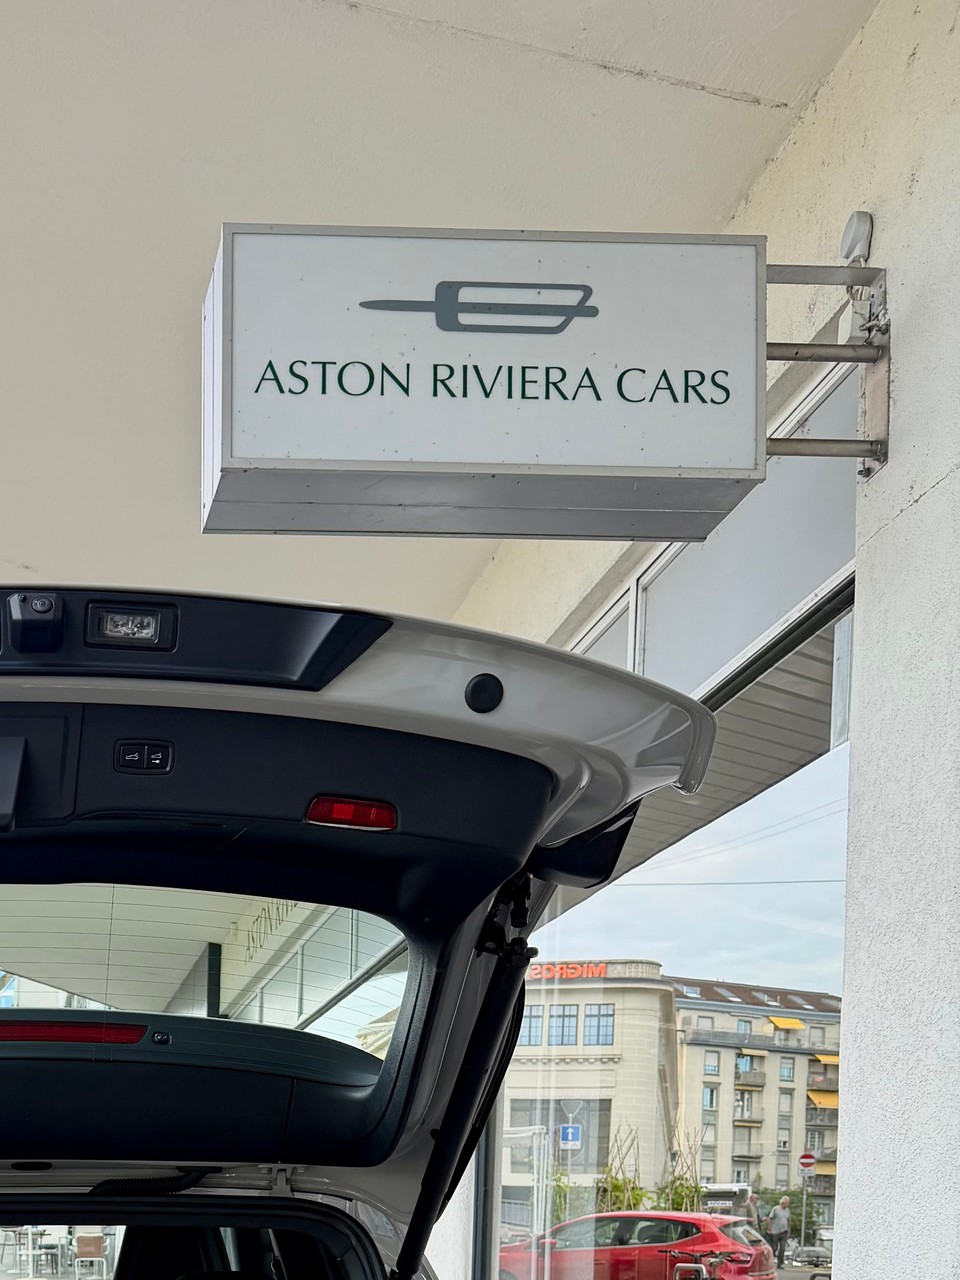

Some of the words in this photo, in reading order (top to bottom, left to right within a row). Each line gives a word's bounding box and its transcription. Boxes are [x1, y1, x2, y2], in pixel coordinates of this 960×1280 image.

[254, 359, 411, 398] ASTON
[432, 363, 603, 402] RIVIERA
[616, 367, 731, 405] CARS
